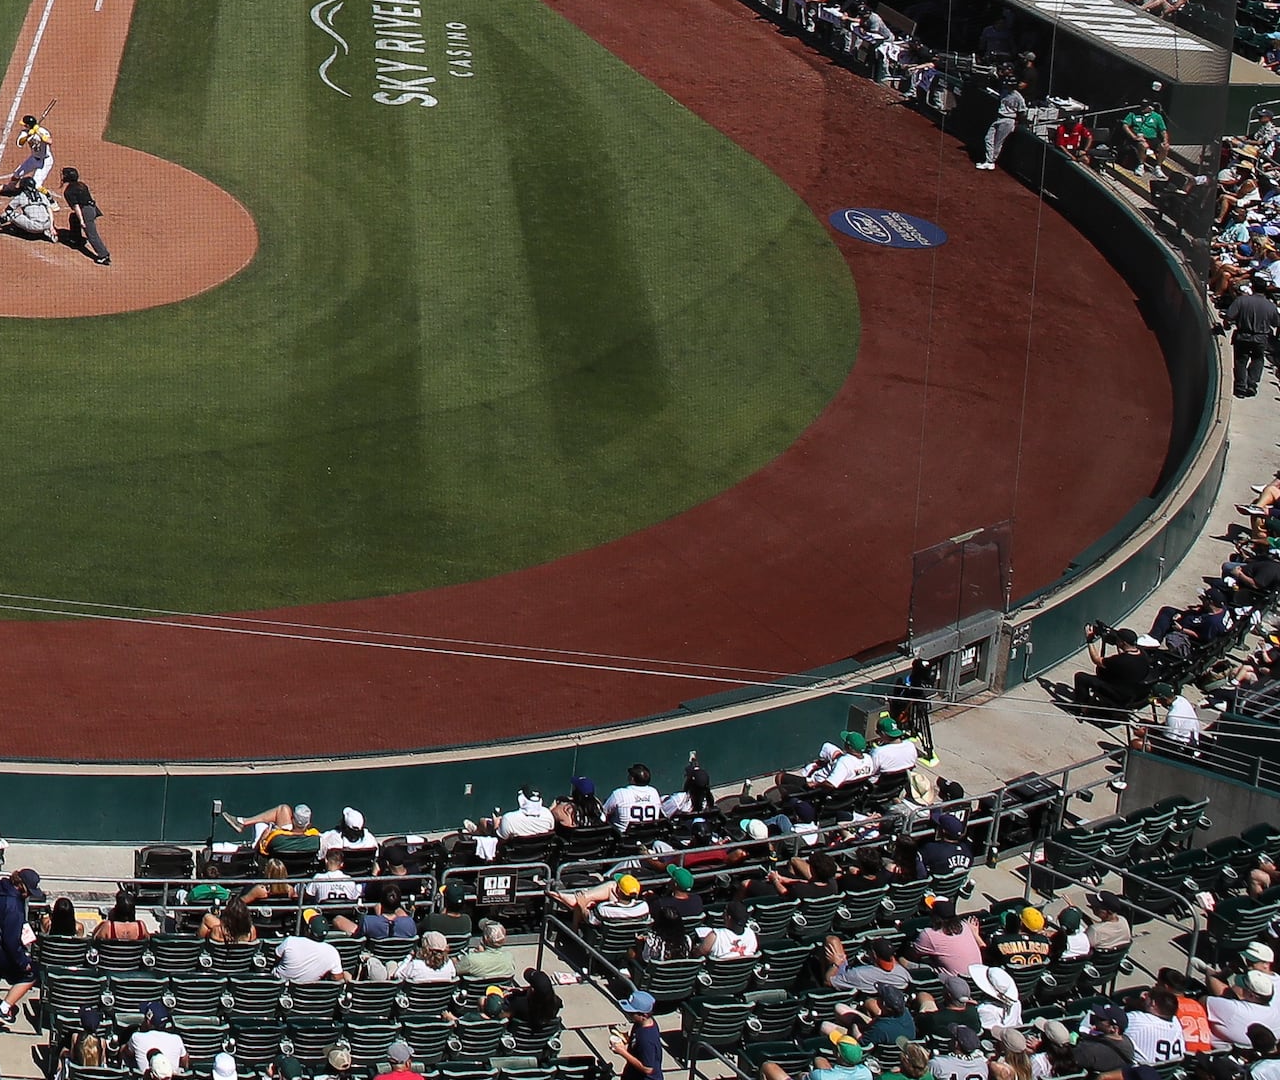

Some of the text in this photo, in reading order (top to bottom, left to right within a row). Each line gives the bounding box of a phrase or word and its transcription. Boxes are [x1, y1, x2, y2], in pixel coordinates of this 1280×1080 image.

[446, 22, 474, 78] CASINO
[372, 57, 438, 107] SKY
[631, 805, 656, 822] 99
[948, 855, 970, 869] JETER
